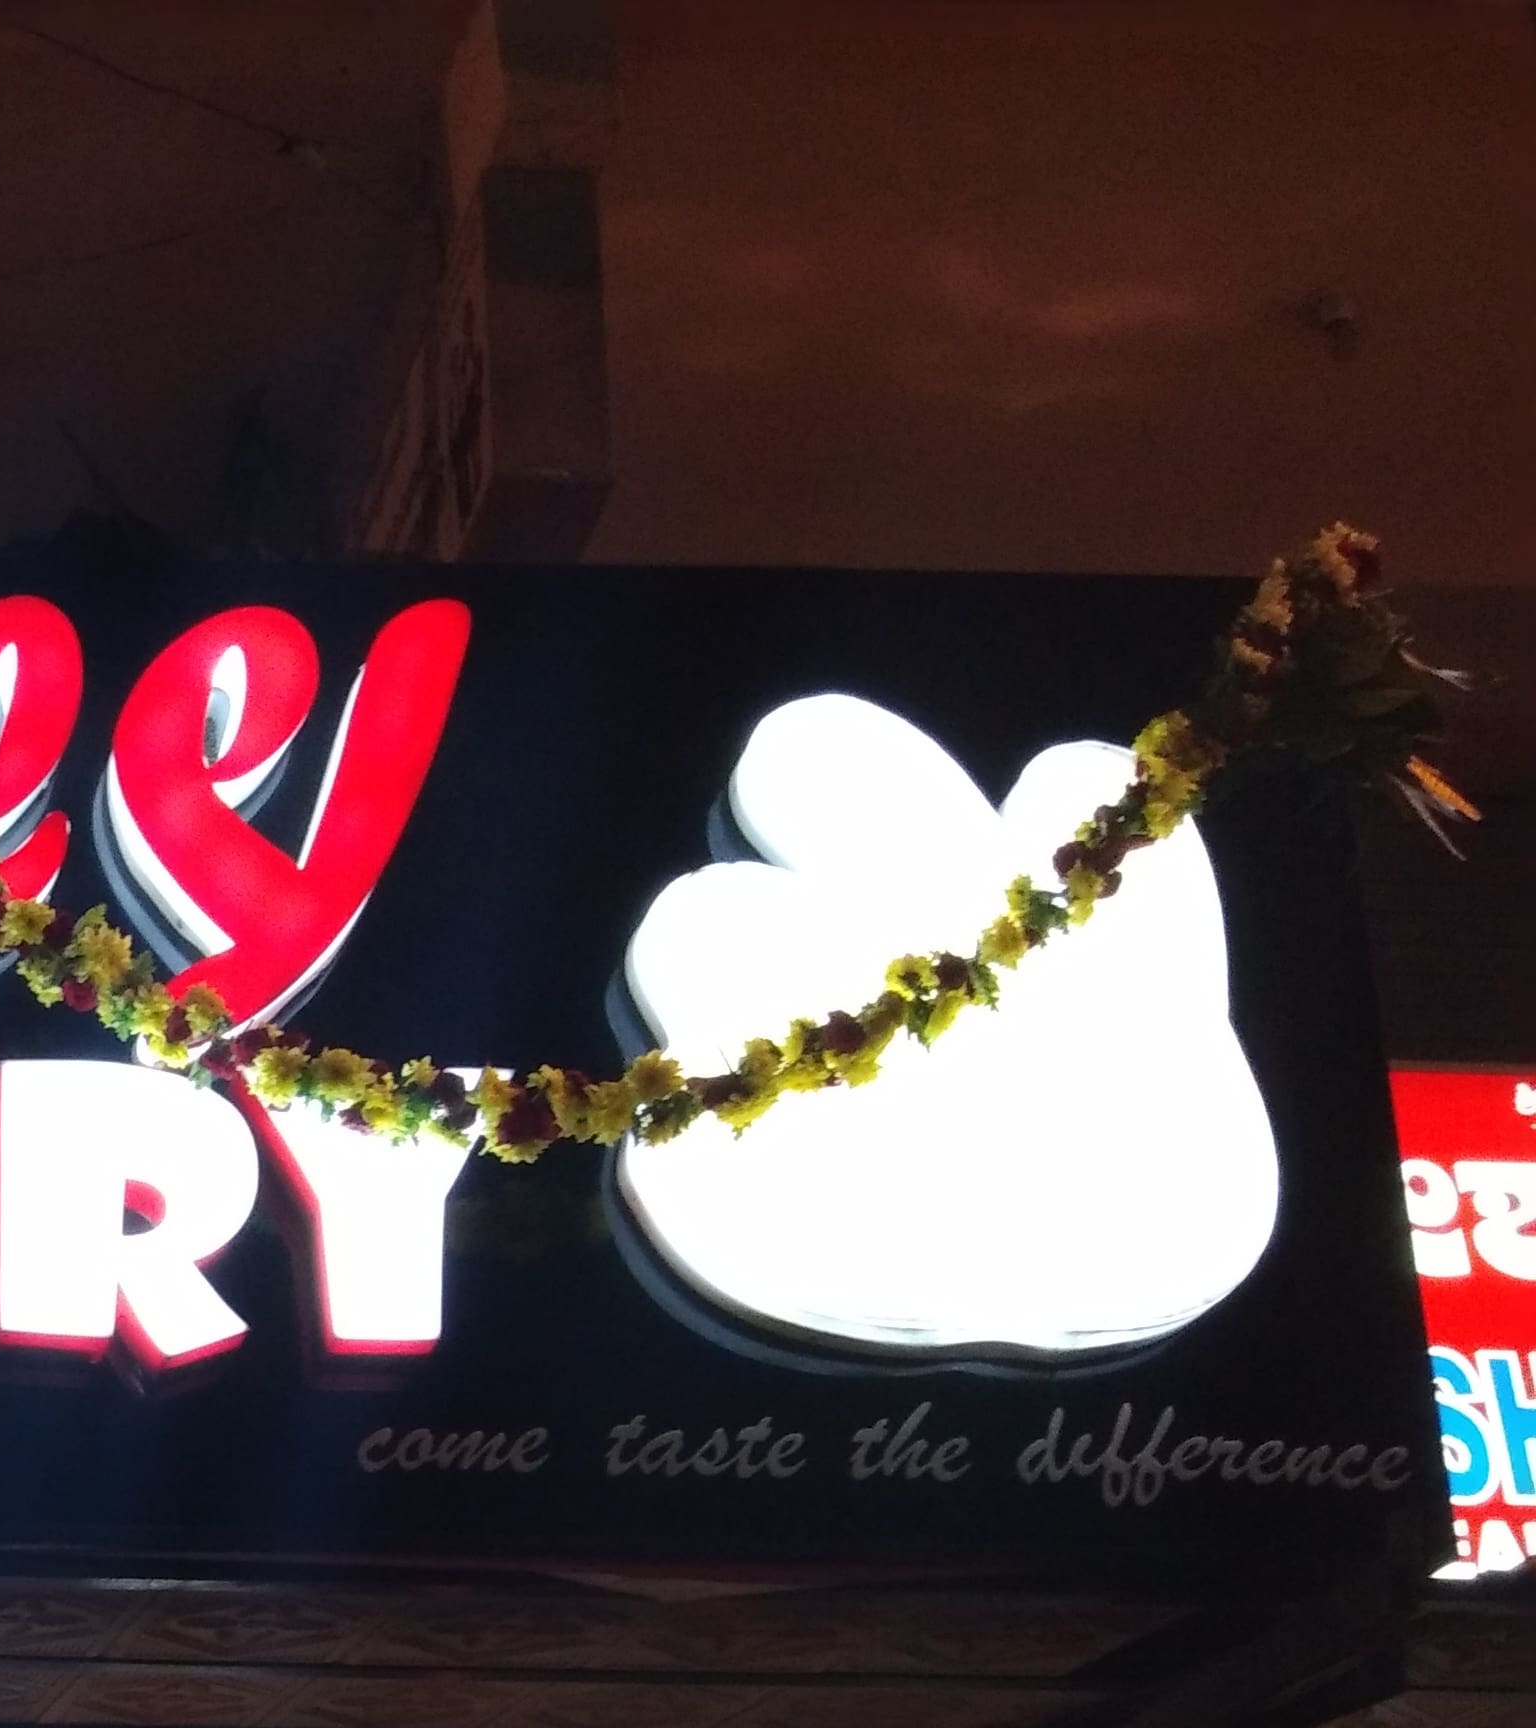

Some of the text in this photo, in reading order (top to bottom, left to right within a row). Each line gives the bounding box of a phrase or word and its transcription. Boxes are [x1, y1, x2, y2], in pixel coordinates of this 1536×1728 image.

[357, 1402, 1412, 1508] come taste the difference
